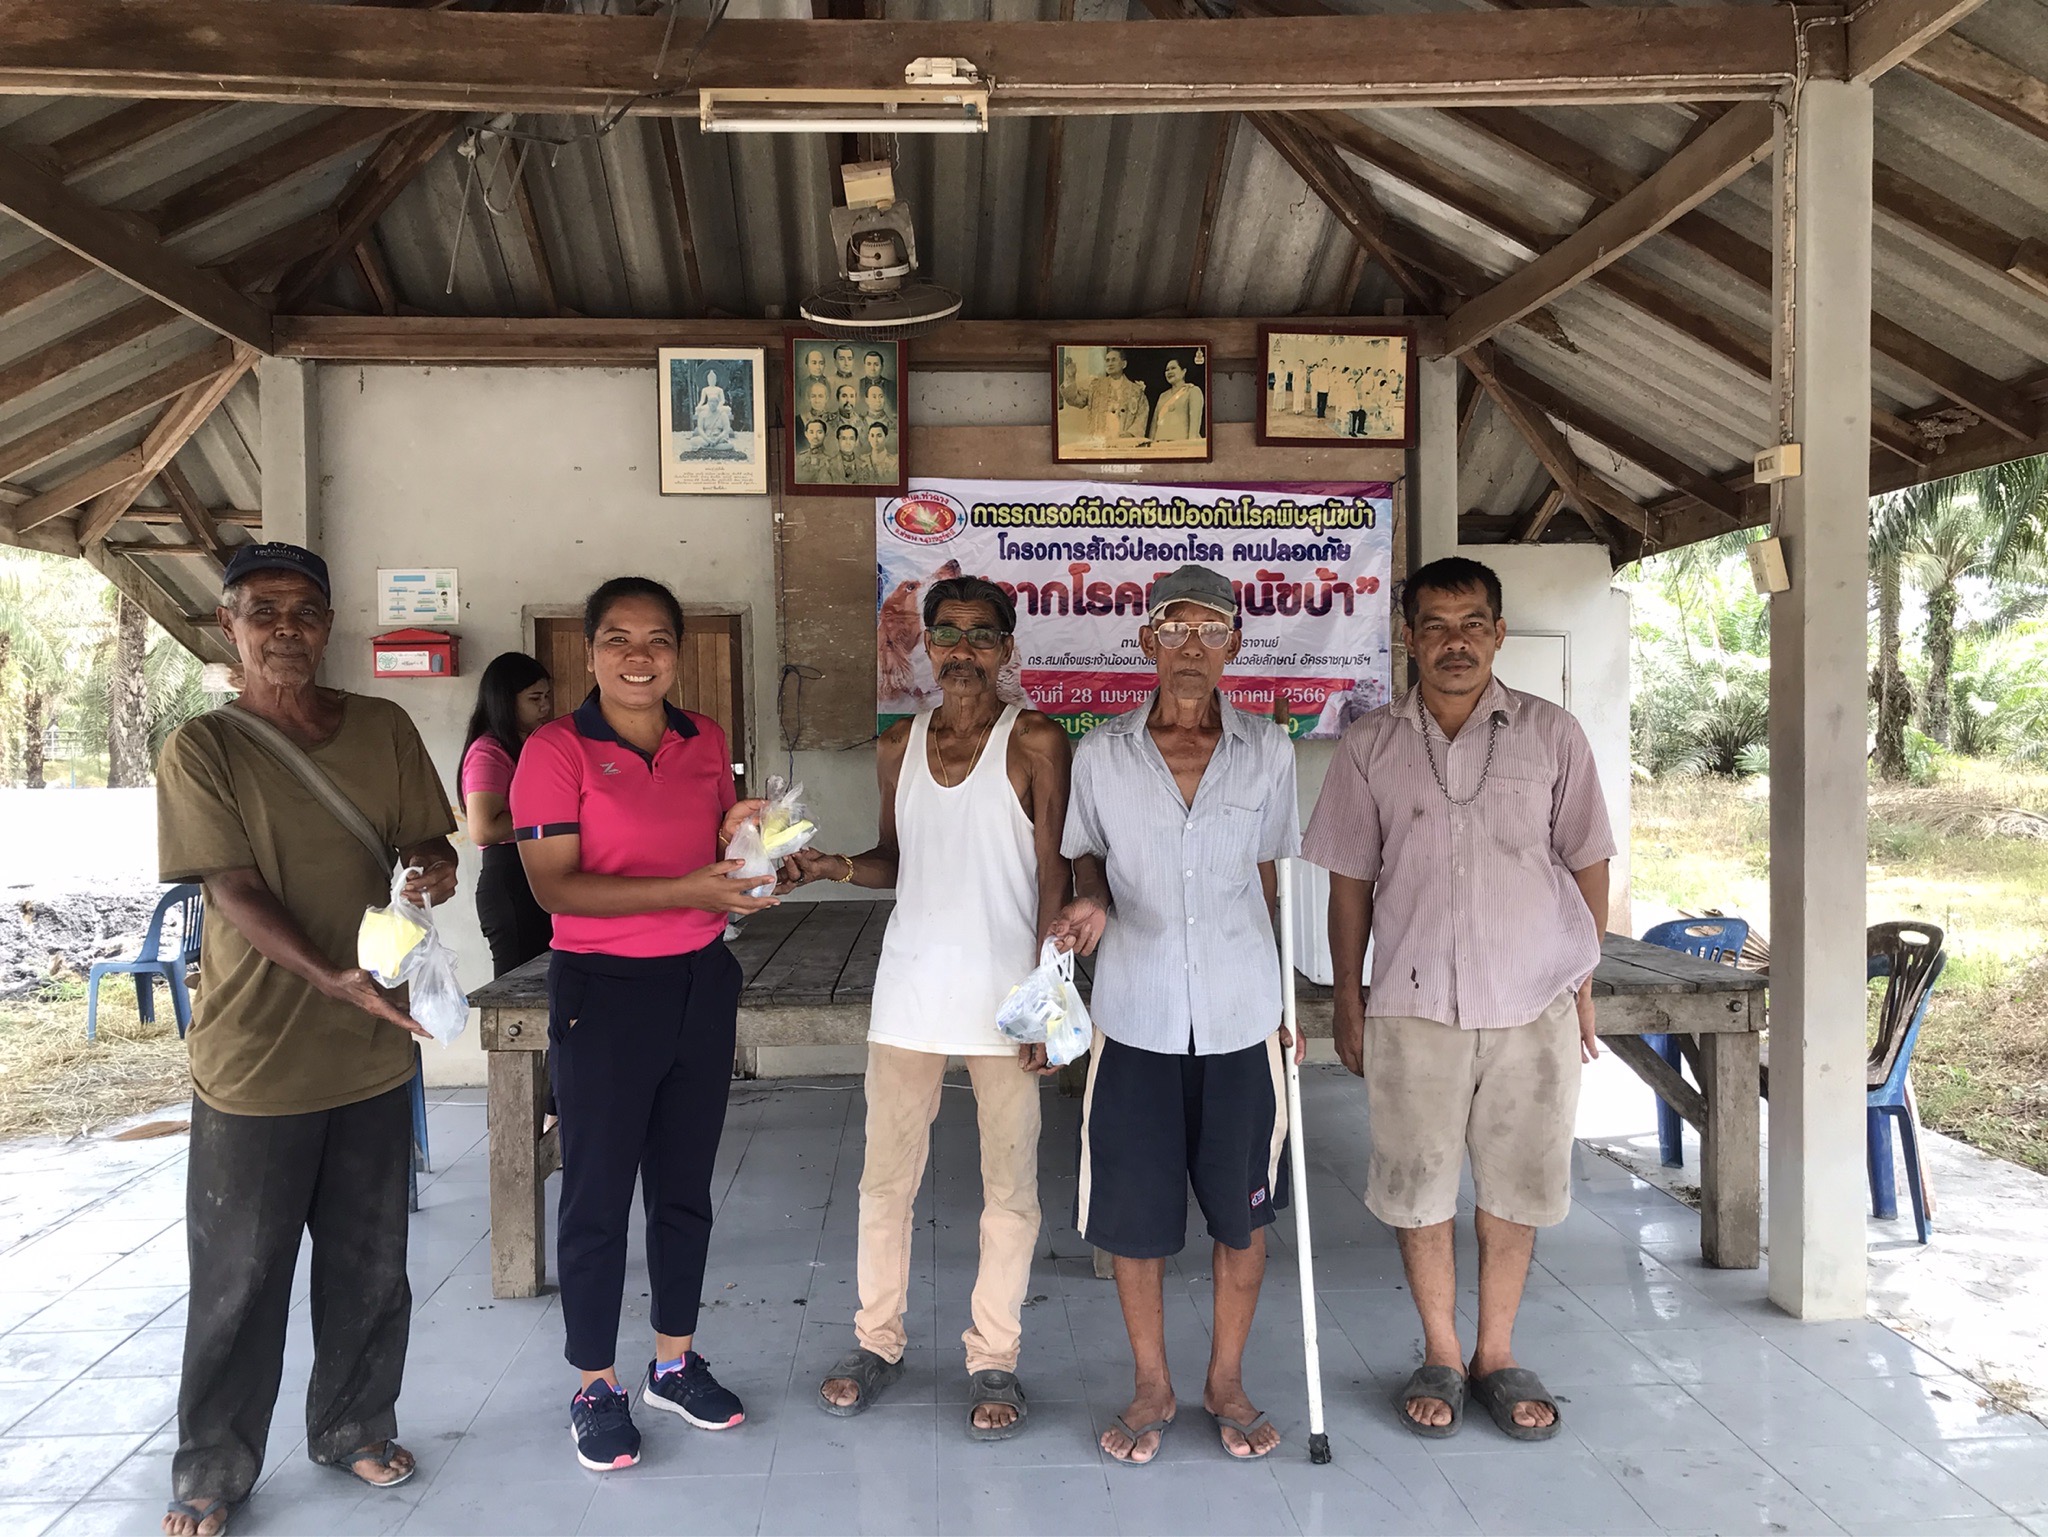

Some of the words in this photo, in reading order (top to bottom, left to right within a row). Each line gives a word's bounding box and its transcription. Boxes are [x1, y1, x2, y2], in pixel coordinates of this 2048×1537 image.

[998, 532, 1223, 561] โครงการสัตว์ปลอดโรค
[1232, 536, 1352, 561] คนปลอดภัย
[1031, 682, 1063, 703] วันที่
[1071, 688, 1092, 703] 28
[1100, 689, 1152, 703] เมษาย
[1282, 687, 1326, 703] 2566
